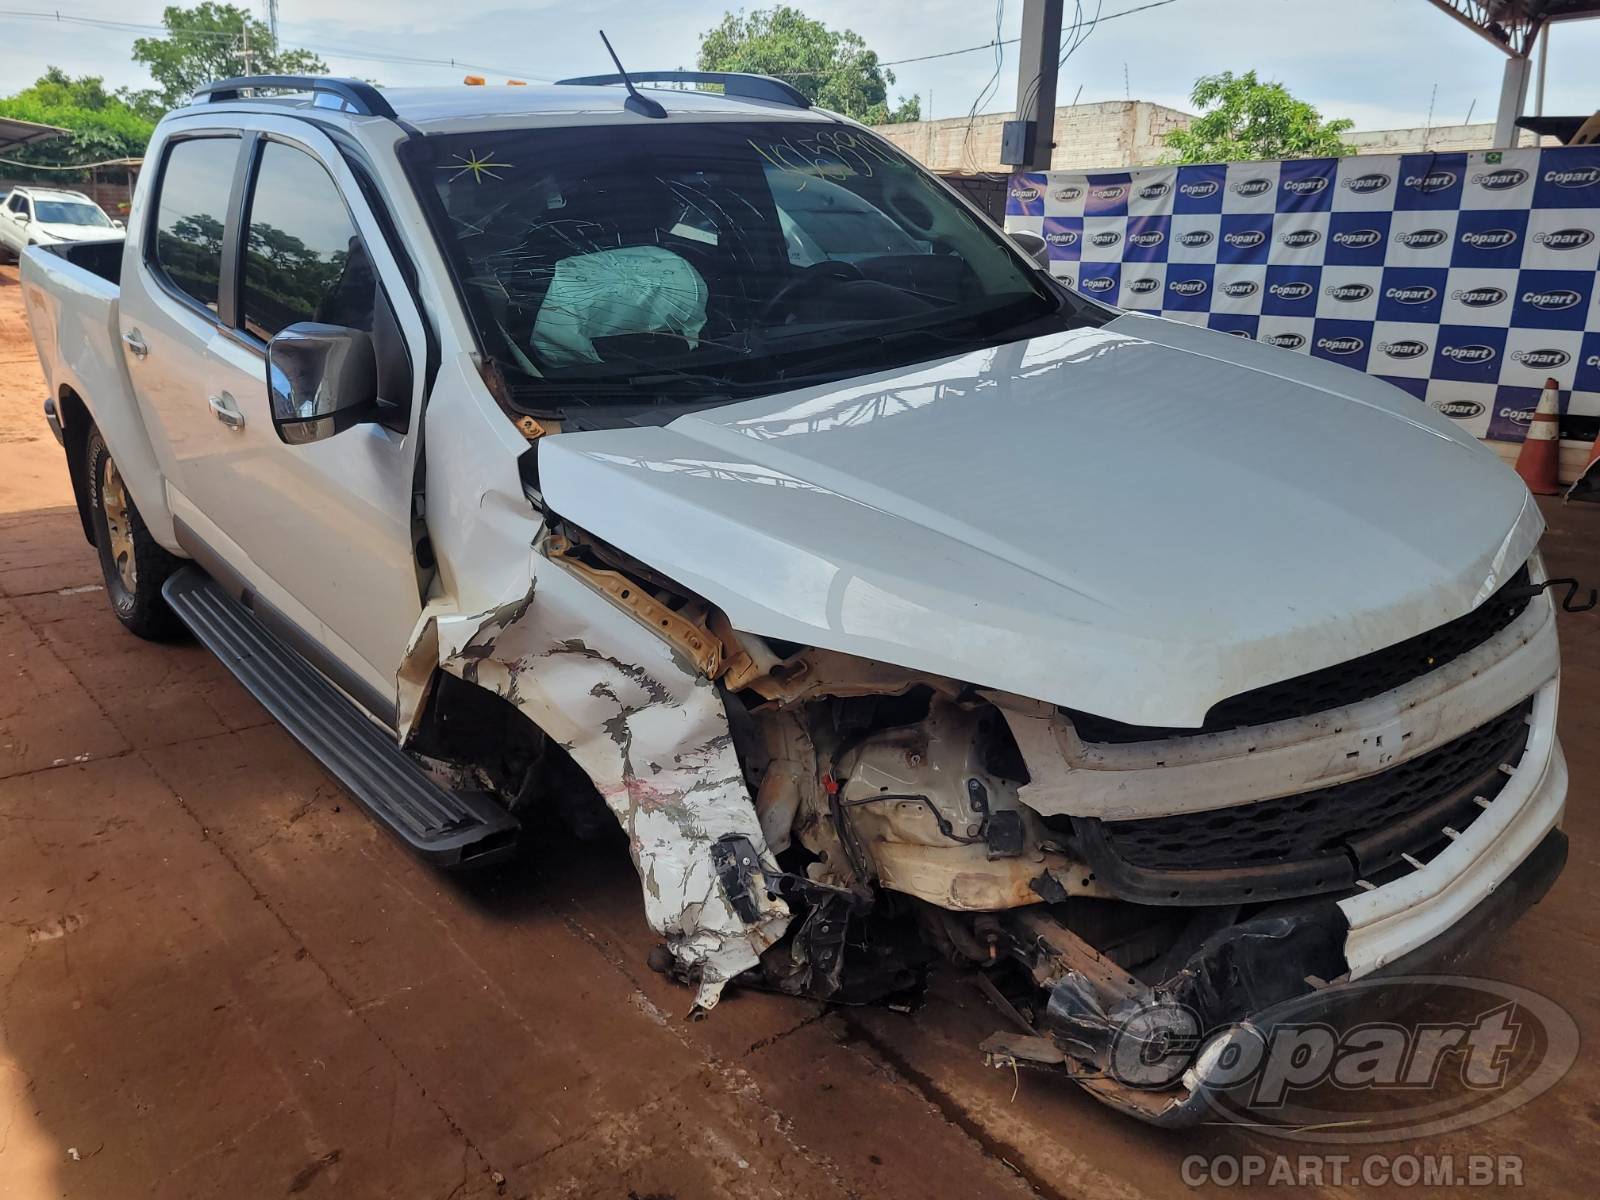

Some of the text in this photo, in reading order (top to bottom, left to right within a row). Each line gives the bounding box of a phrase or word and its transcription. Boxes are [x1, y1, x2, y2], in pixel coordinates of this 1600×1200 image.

[1342, 177, 1384, 190] Copart
[1472, 172, 1521, 185] Copart
[1544, 170, 1598, 184] Copart
[1180, 184, 1214, 195] Copart
[1283, 179, 1324, 191] Copart
[1011, 188, 1038, 199] Copart
[1046, 233, 1074, 244] Copart
[1130, 233, 1161, 244] Copart
[1175, 232, 1210, 244] Copart
[1224, 232, 1260, 244] Copart
[1279, 232, 1314, 244] Copart
[1333, 232, 1376, 245] Copart
[1394, 232, 1441, 246] Copart
[1461, 232, 1511, 246] Copart
[1533, 231, 1588, 245] Copart
[1082, 279, 1110, 290] Copart
[1169, 281, 1203, 293] Copart
[1269, 284, 1307, 296] Copart
[1325, 286, 1367, 298] Copart
[1385, 288, 1431, 301] Copart
[1451, 290, 1500, 303] Copart
[1522, 292, 1574, 305] Copart
[1317, 338, 1359, 351] Copart
[1377, 342, 1421, 355] Copart
[1441, 346, 1490, 359] Copart
[1511, 350, 1562, 364] Copart
[1431, 401, 1478, 414] Copart
[1500, 408, 1535, 420] Copa
